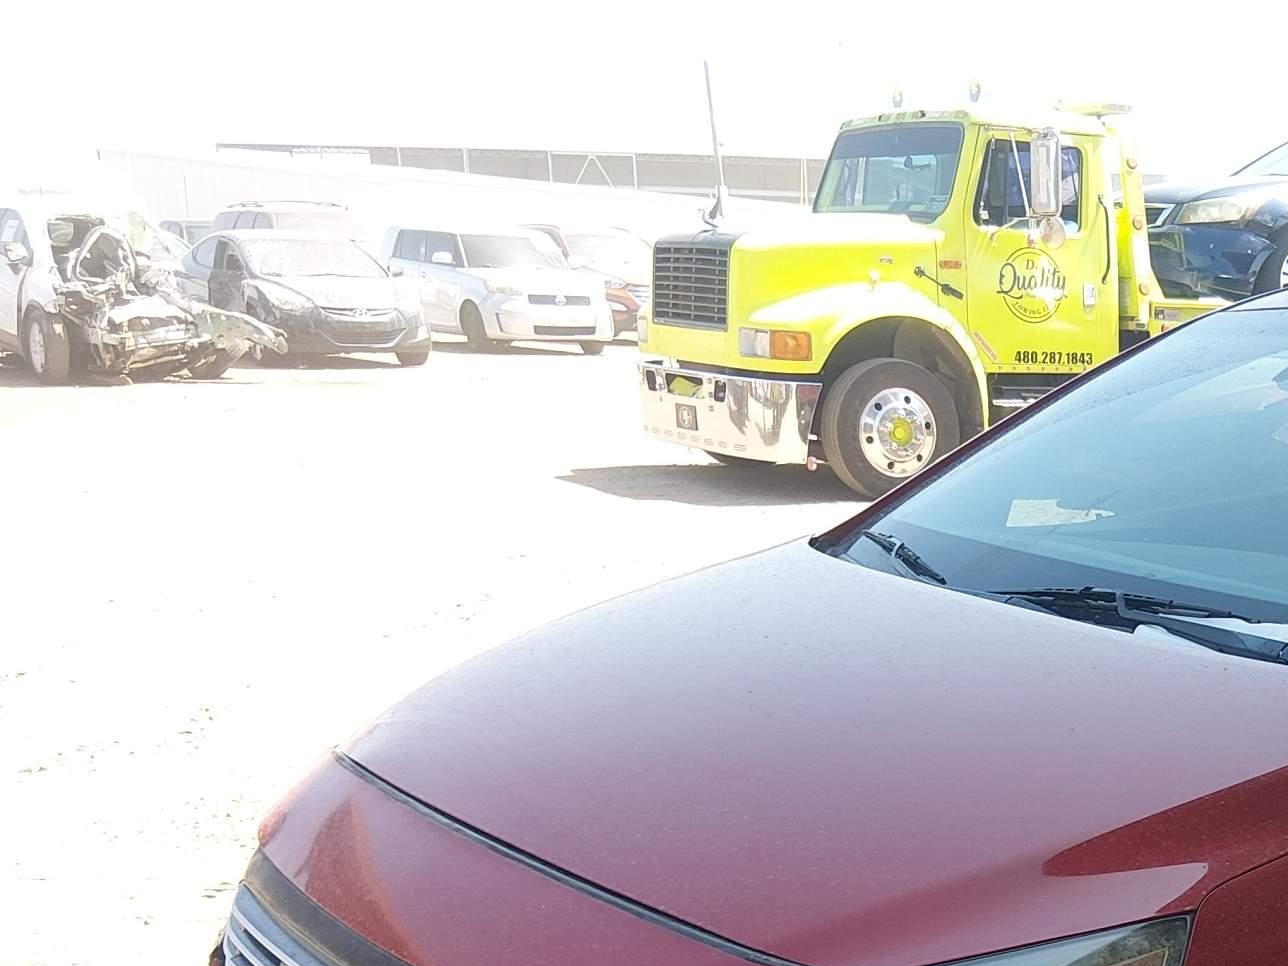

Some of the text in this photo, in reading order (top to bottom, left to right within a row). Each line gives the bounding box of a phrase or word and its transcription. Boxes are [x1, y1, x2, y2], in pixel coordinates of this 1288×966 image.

[996, 262, 1068, 301] Quality
[1014, 301, 1041, 315] TOWING
[1015, 351, 1093, 365] 480.287.1843
